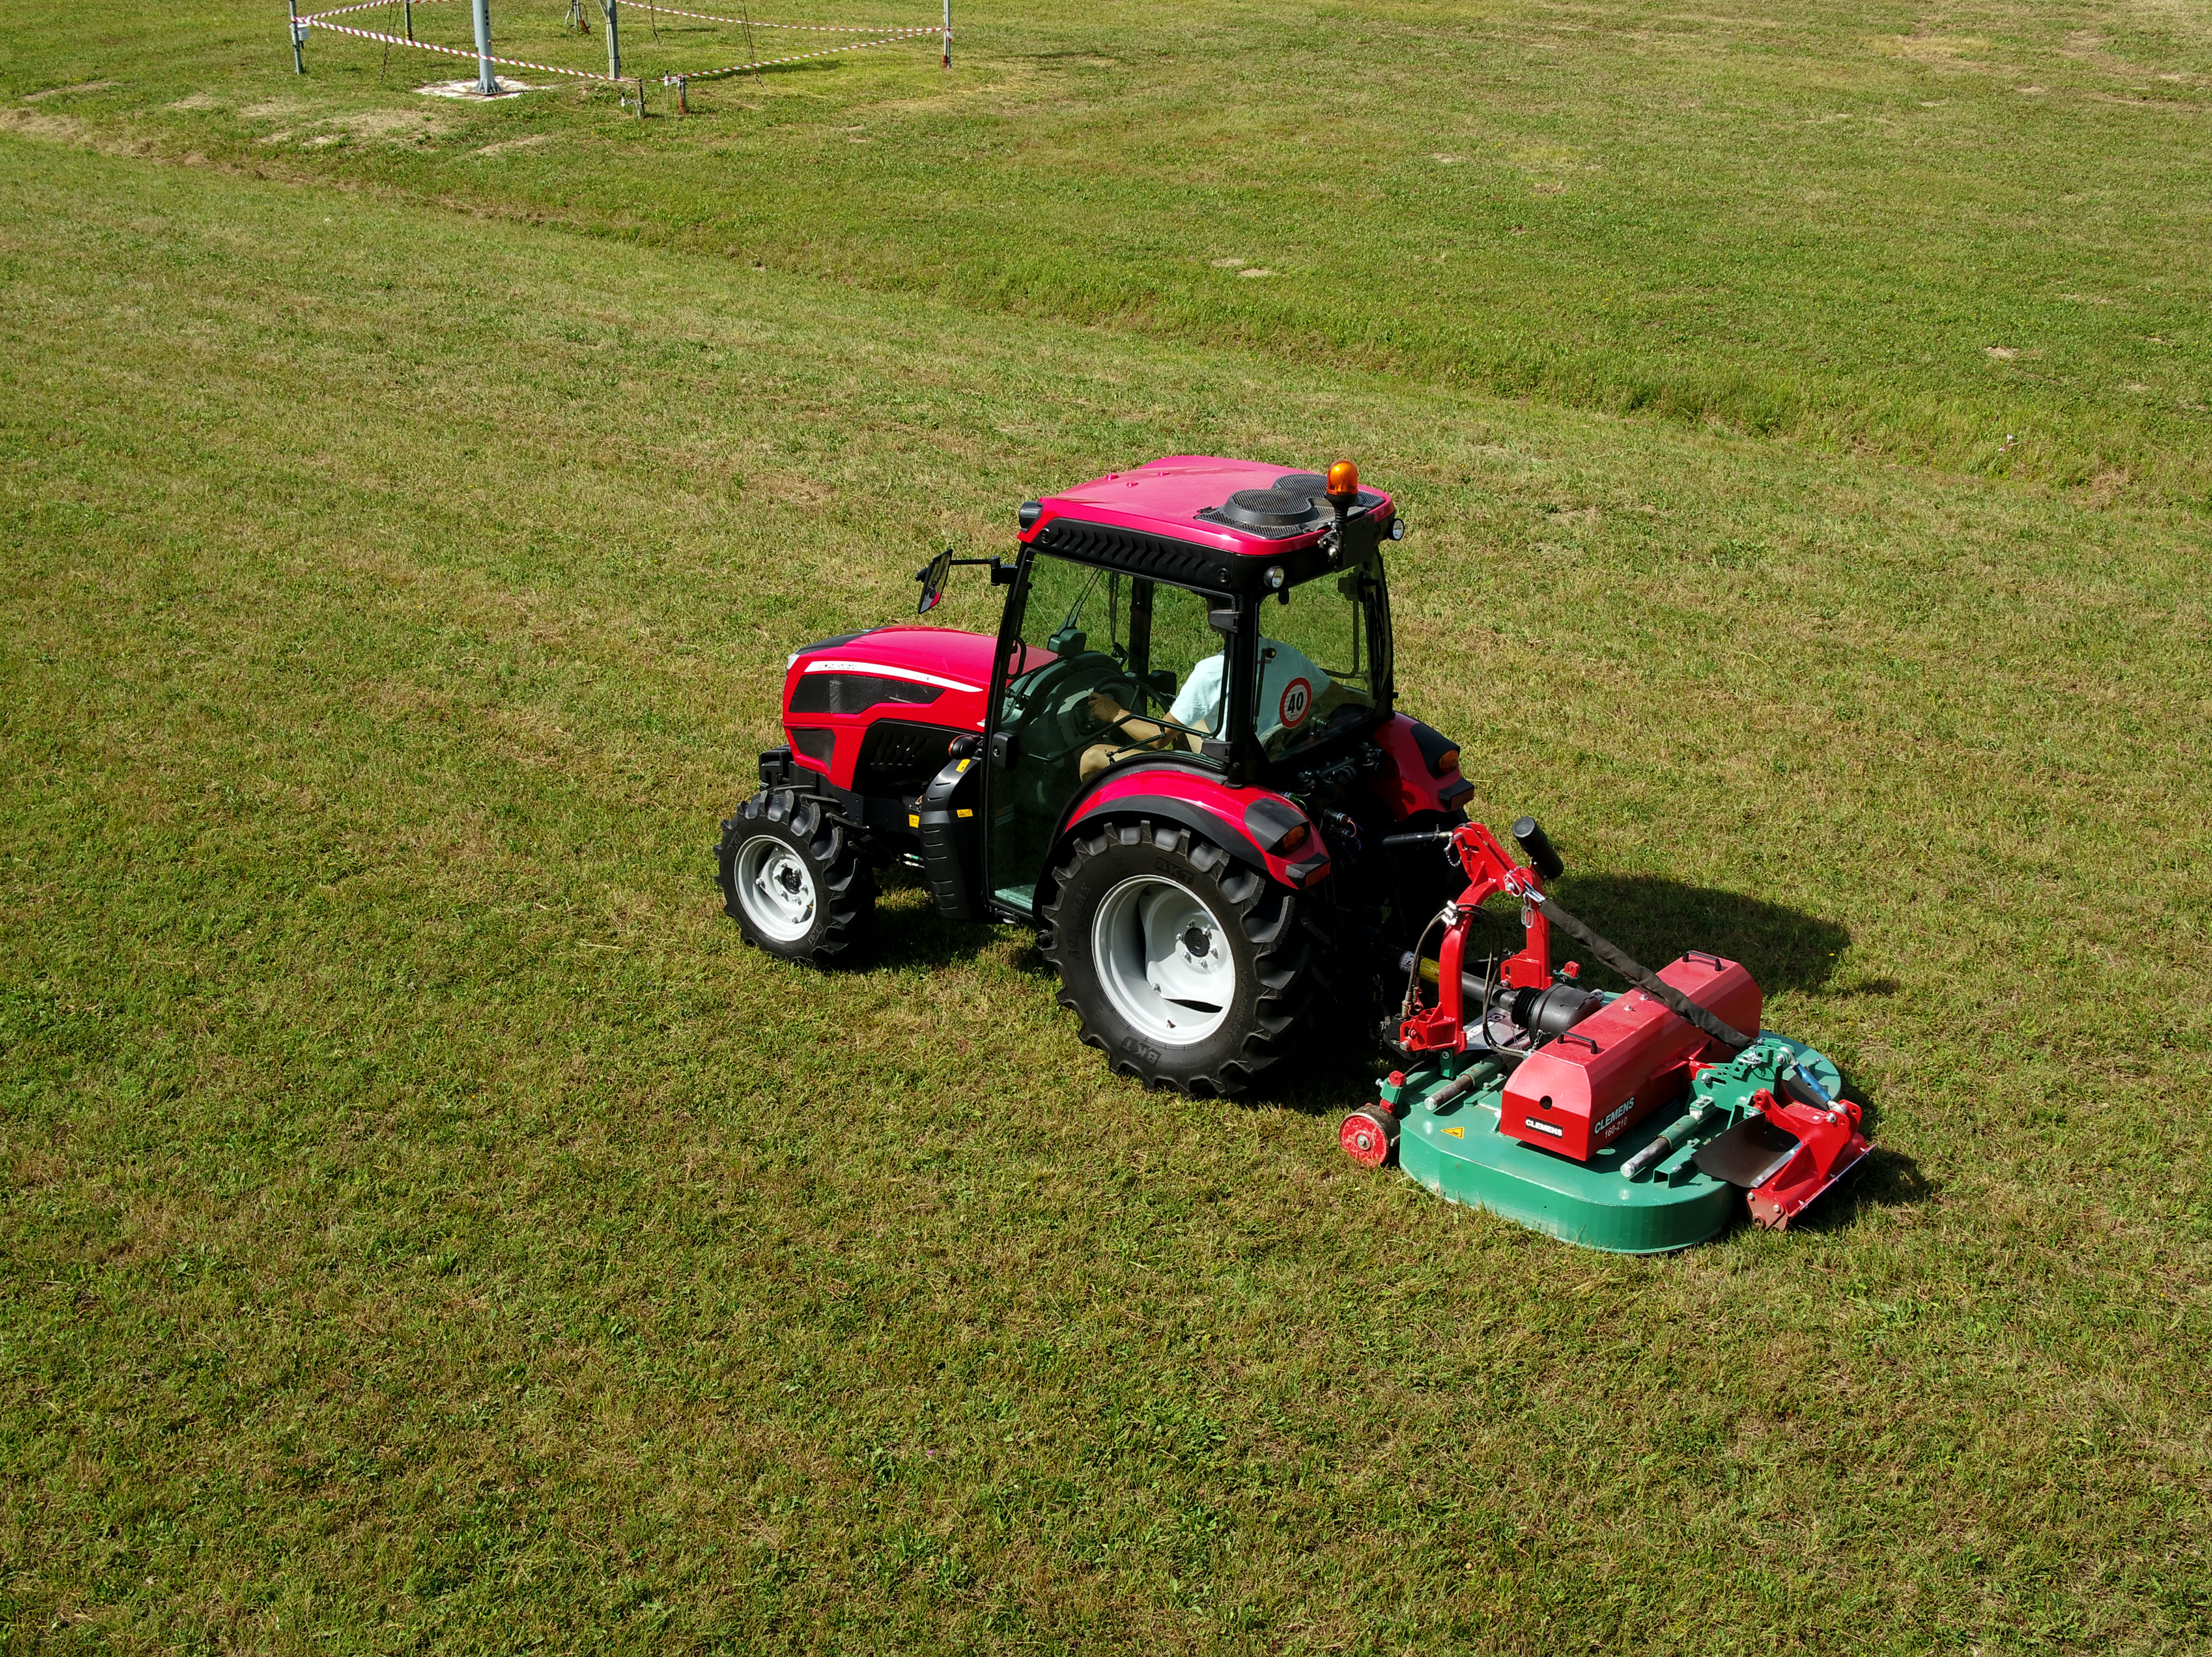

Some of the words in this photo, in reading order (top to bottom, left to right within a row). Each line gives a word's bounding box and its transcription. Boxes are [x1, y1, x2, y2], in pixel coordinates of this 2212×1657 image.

[1287, 692, 1304, 713] 40
[1156, 857, 1193, 884] BKT
[1120, 1038, 1160, 1065] BKT
[1526, 1119, 1562, 1136] CLEMENS
[1594, 1097, 1634, 1134] CLEMENS
[1605, 1117, 1627, 1139] 160-210
